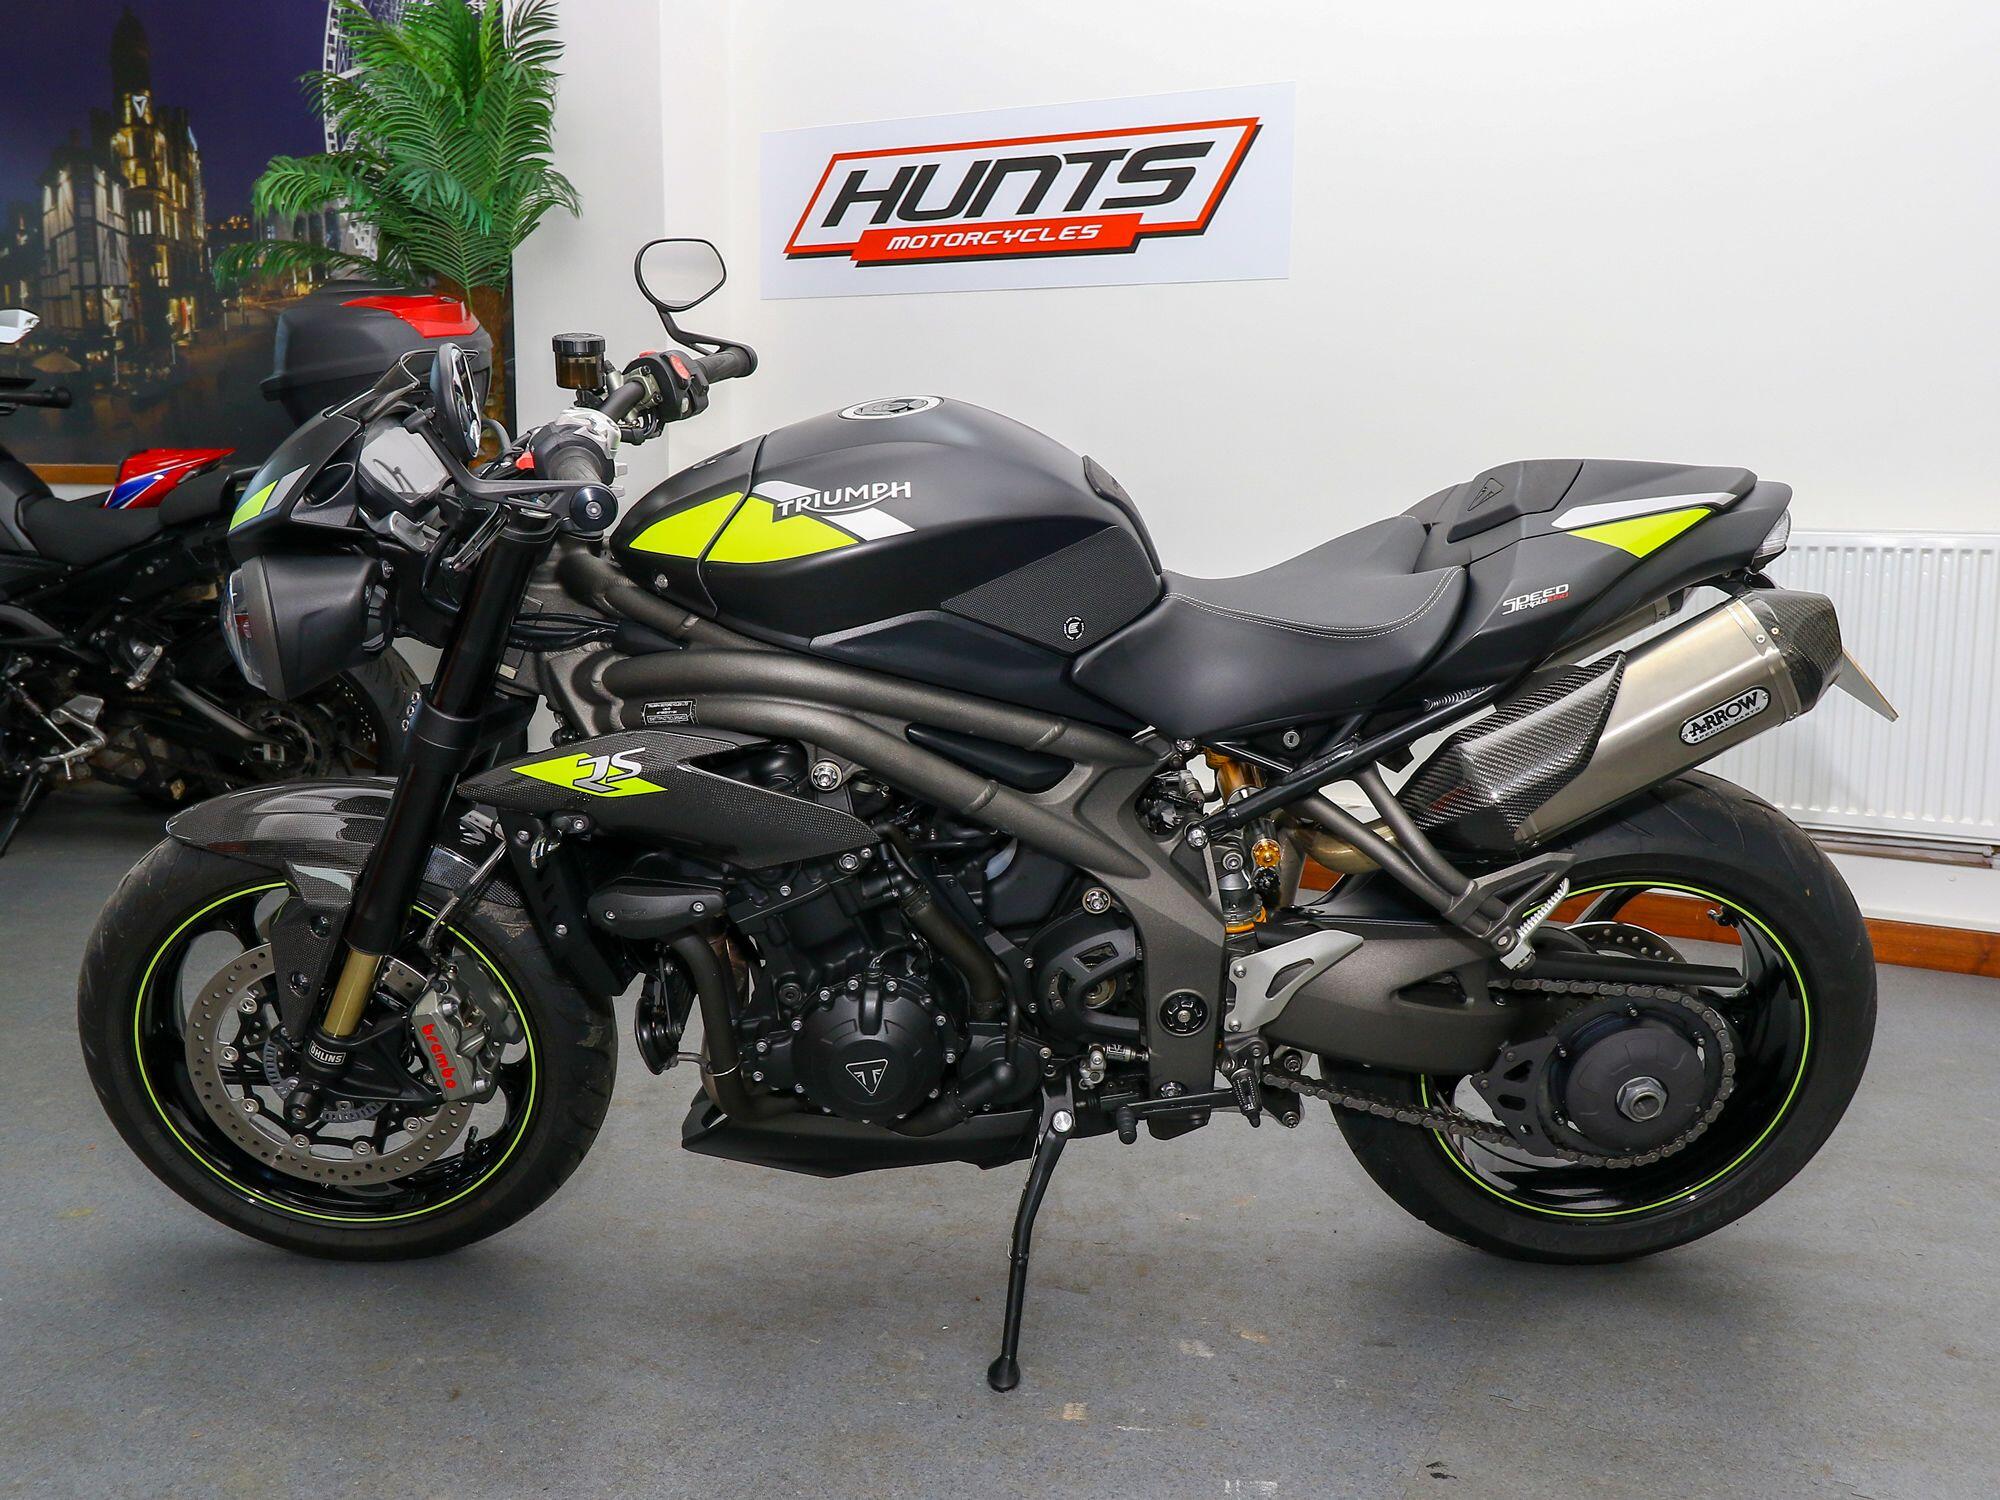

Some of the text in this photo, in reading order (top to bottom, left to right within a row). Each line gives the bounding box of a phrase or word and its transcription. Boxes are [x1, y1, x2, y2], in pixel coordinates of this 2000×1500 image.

[821, 141, 1215, 228] HUNTS
[886, 224, 1103, 251] MOTORCYCLES
[777, 481, 912, 517] TRIUMPH
[1502, 583, 1569, 615] SPEED
[1688, 691, 1758, 738] ARROW
[421, 1023, 457, 1090] brembo
